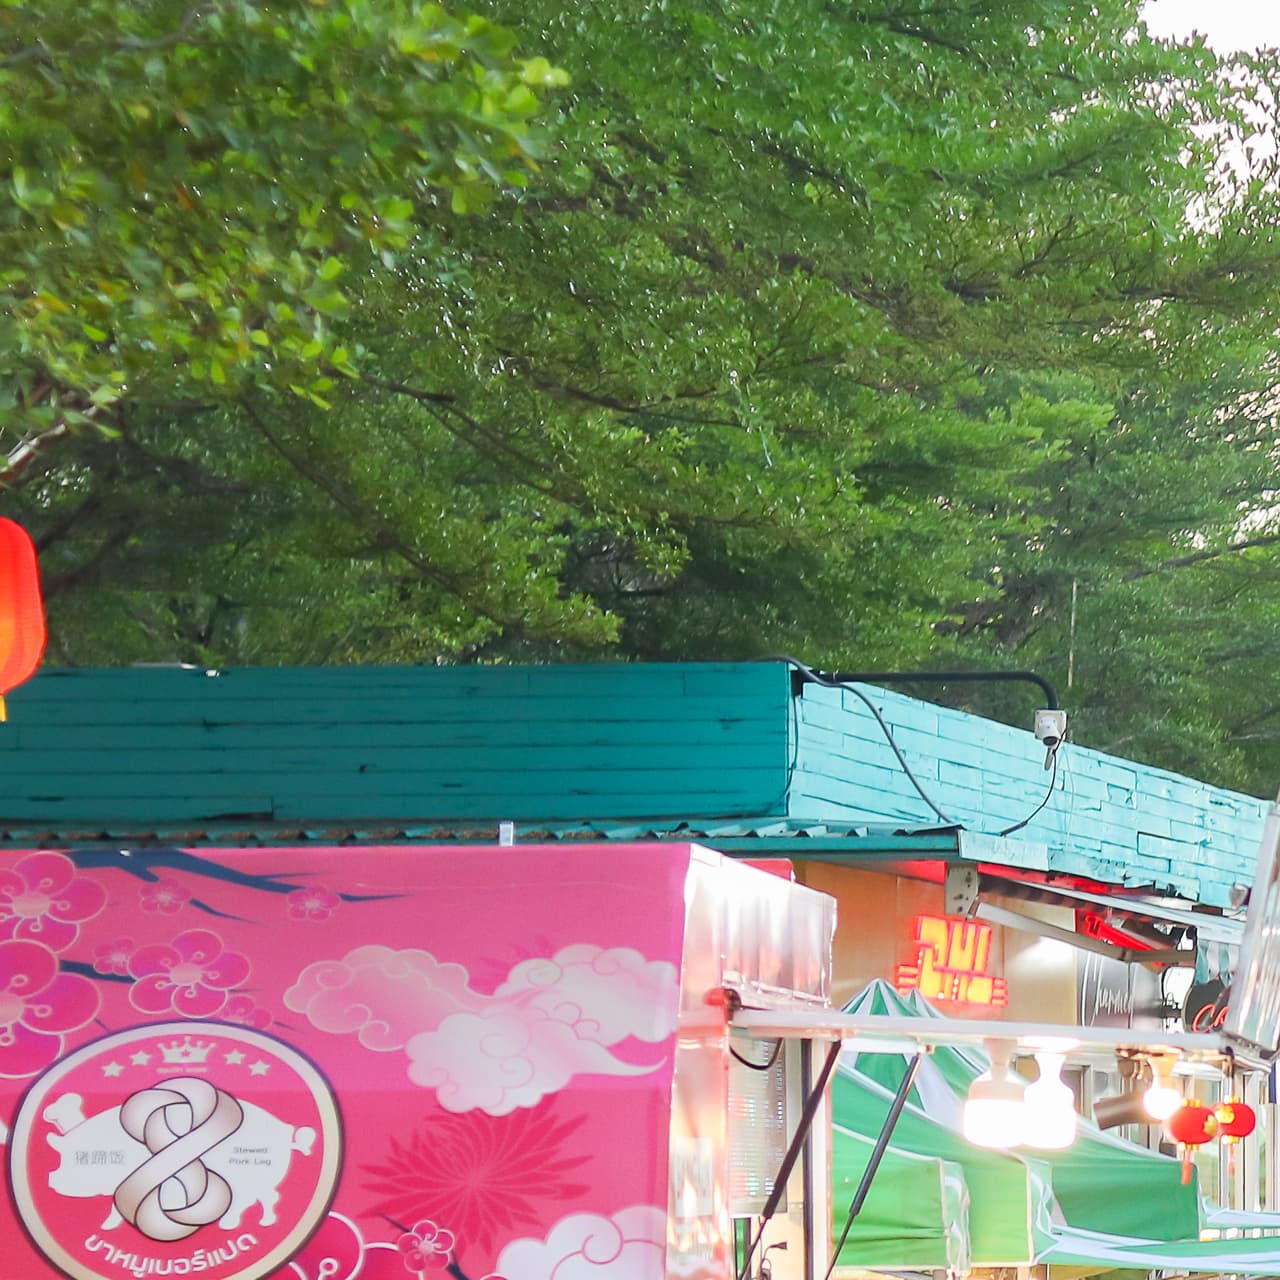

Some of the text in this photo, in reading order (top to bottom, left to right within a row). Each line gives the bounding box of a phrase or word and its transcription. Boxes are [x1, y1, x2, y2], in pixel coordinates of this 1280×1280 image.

[85, 1233, 258, 1278] ขาหมูเบอร์แปด
